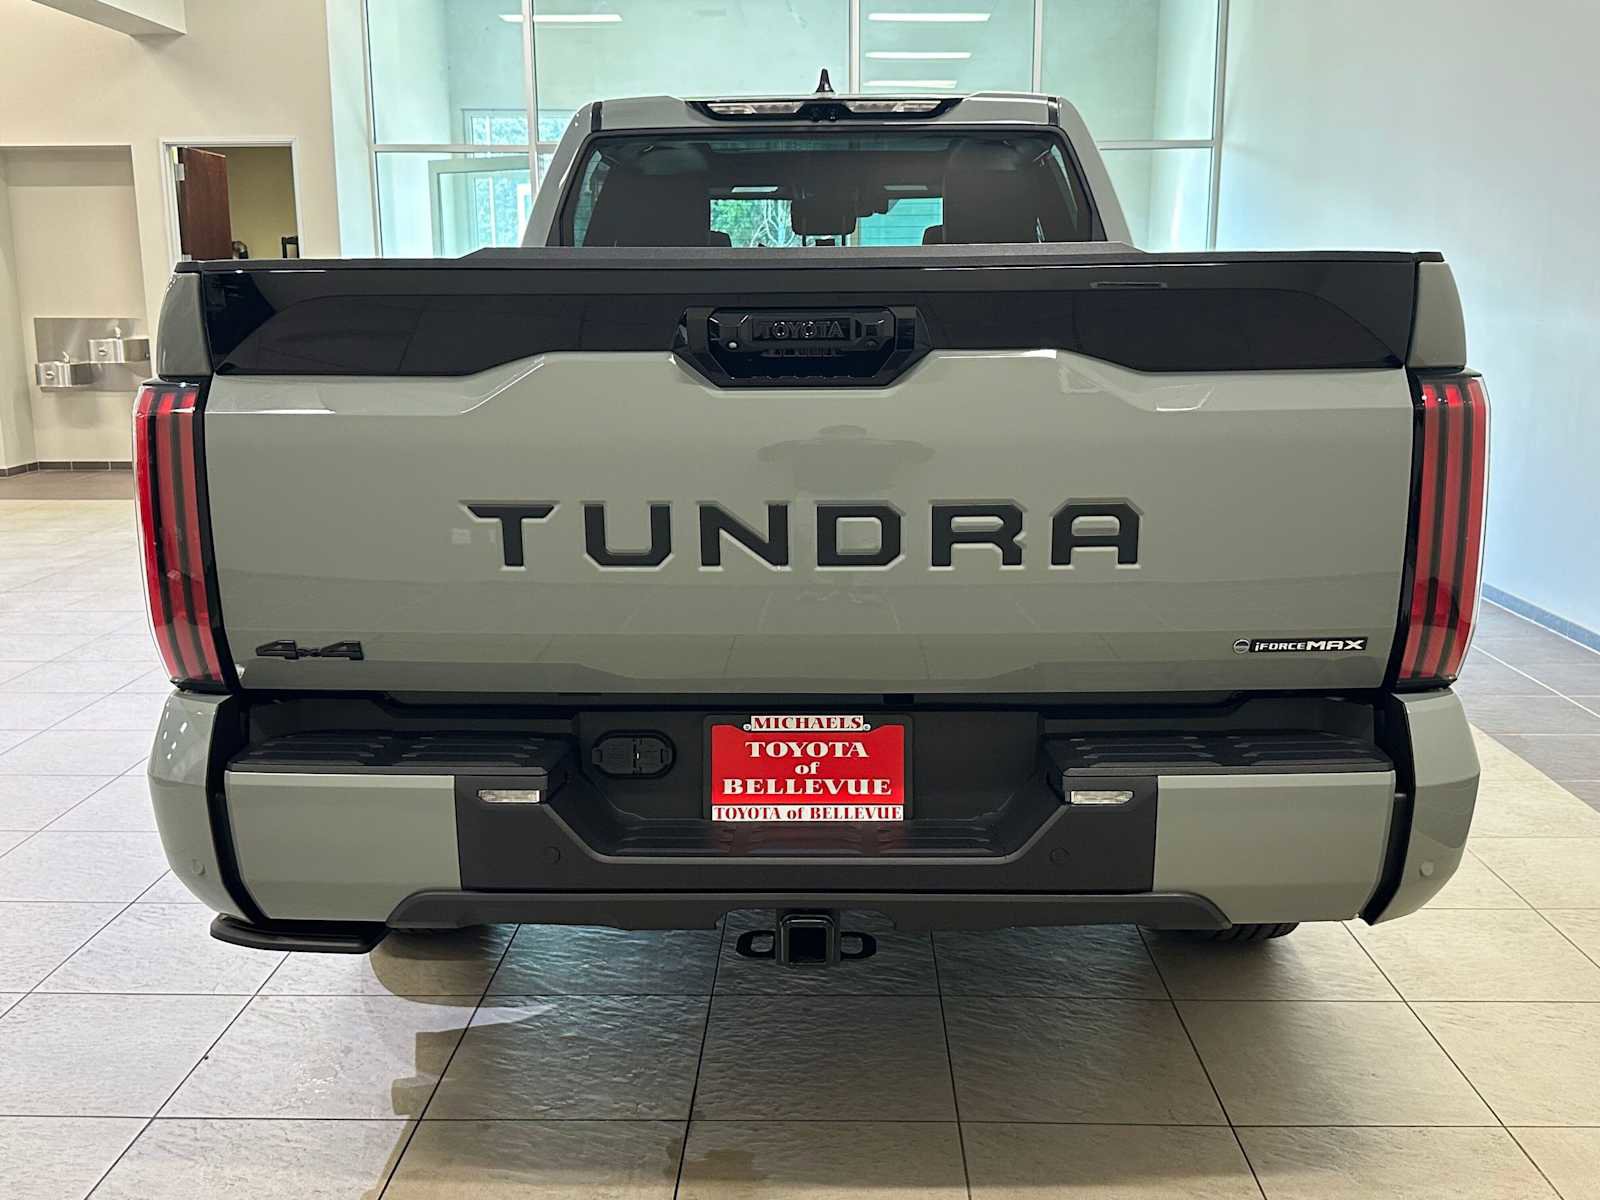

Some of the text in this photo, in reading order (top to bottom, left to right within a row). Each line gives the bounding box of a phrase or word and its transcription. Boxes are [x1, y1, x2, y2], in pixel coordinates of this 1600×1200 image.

[758, 320, 845, 339] TOYOTA
[463, 500, 1143, 570] TUNDRA
[754, 717, 862, 730] MICHAELS
[745, 742, 869, 758] TOYOTA
[794, 761, 820, 775] of
[722, 779, 892, 795] BELLEVUE
[714, 807, 902, 820] TOYOTA of BELLEVUE
